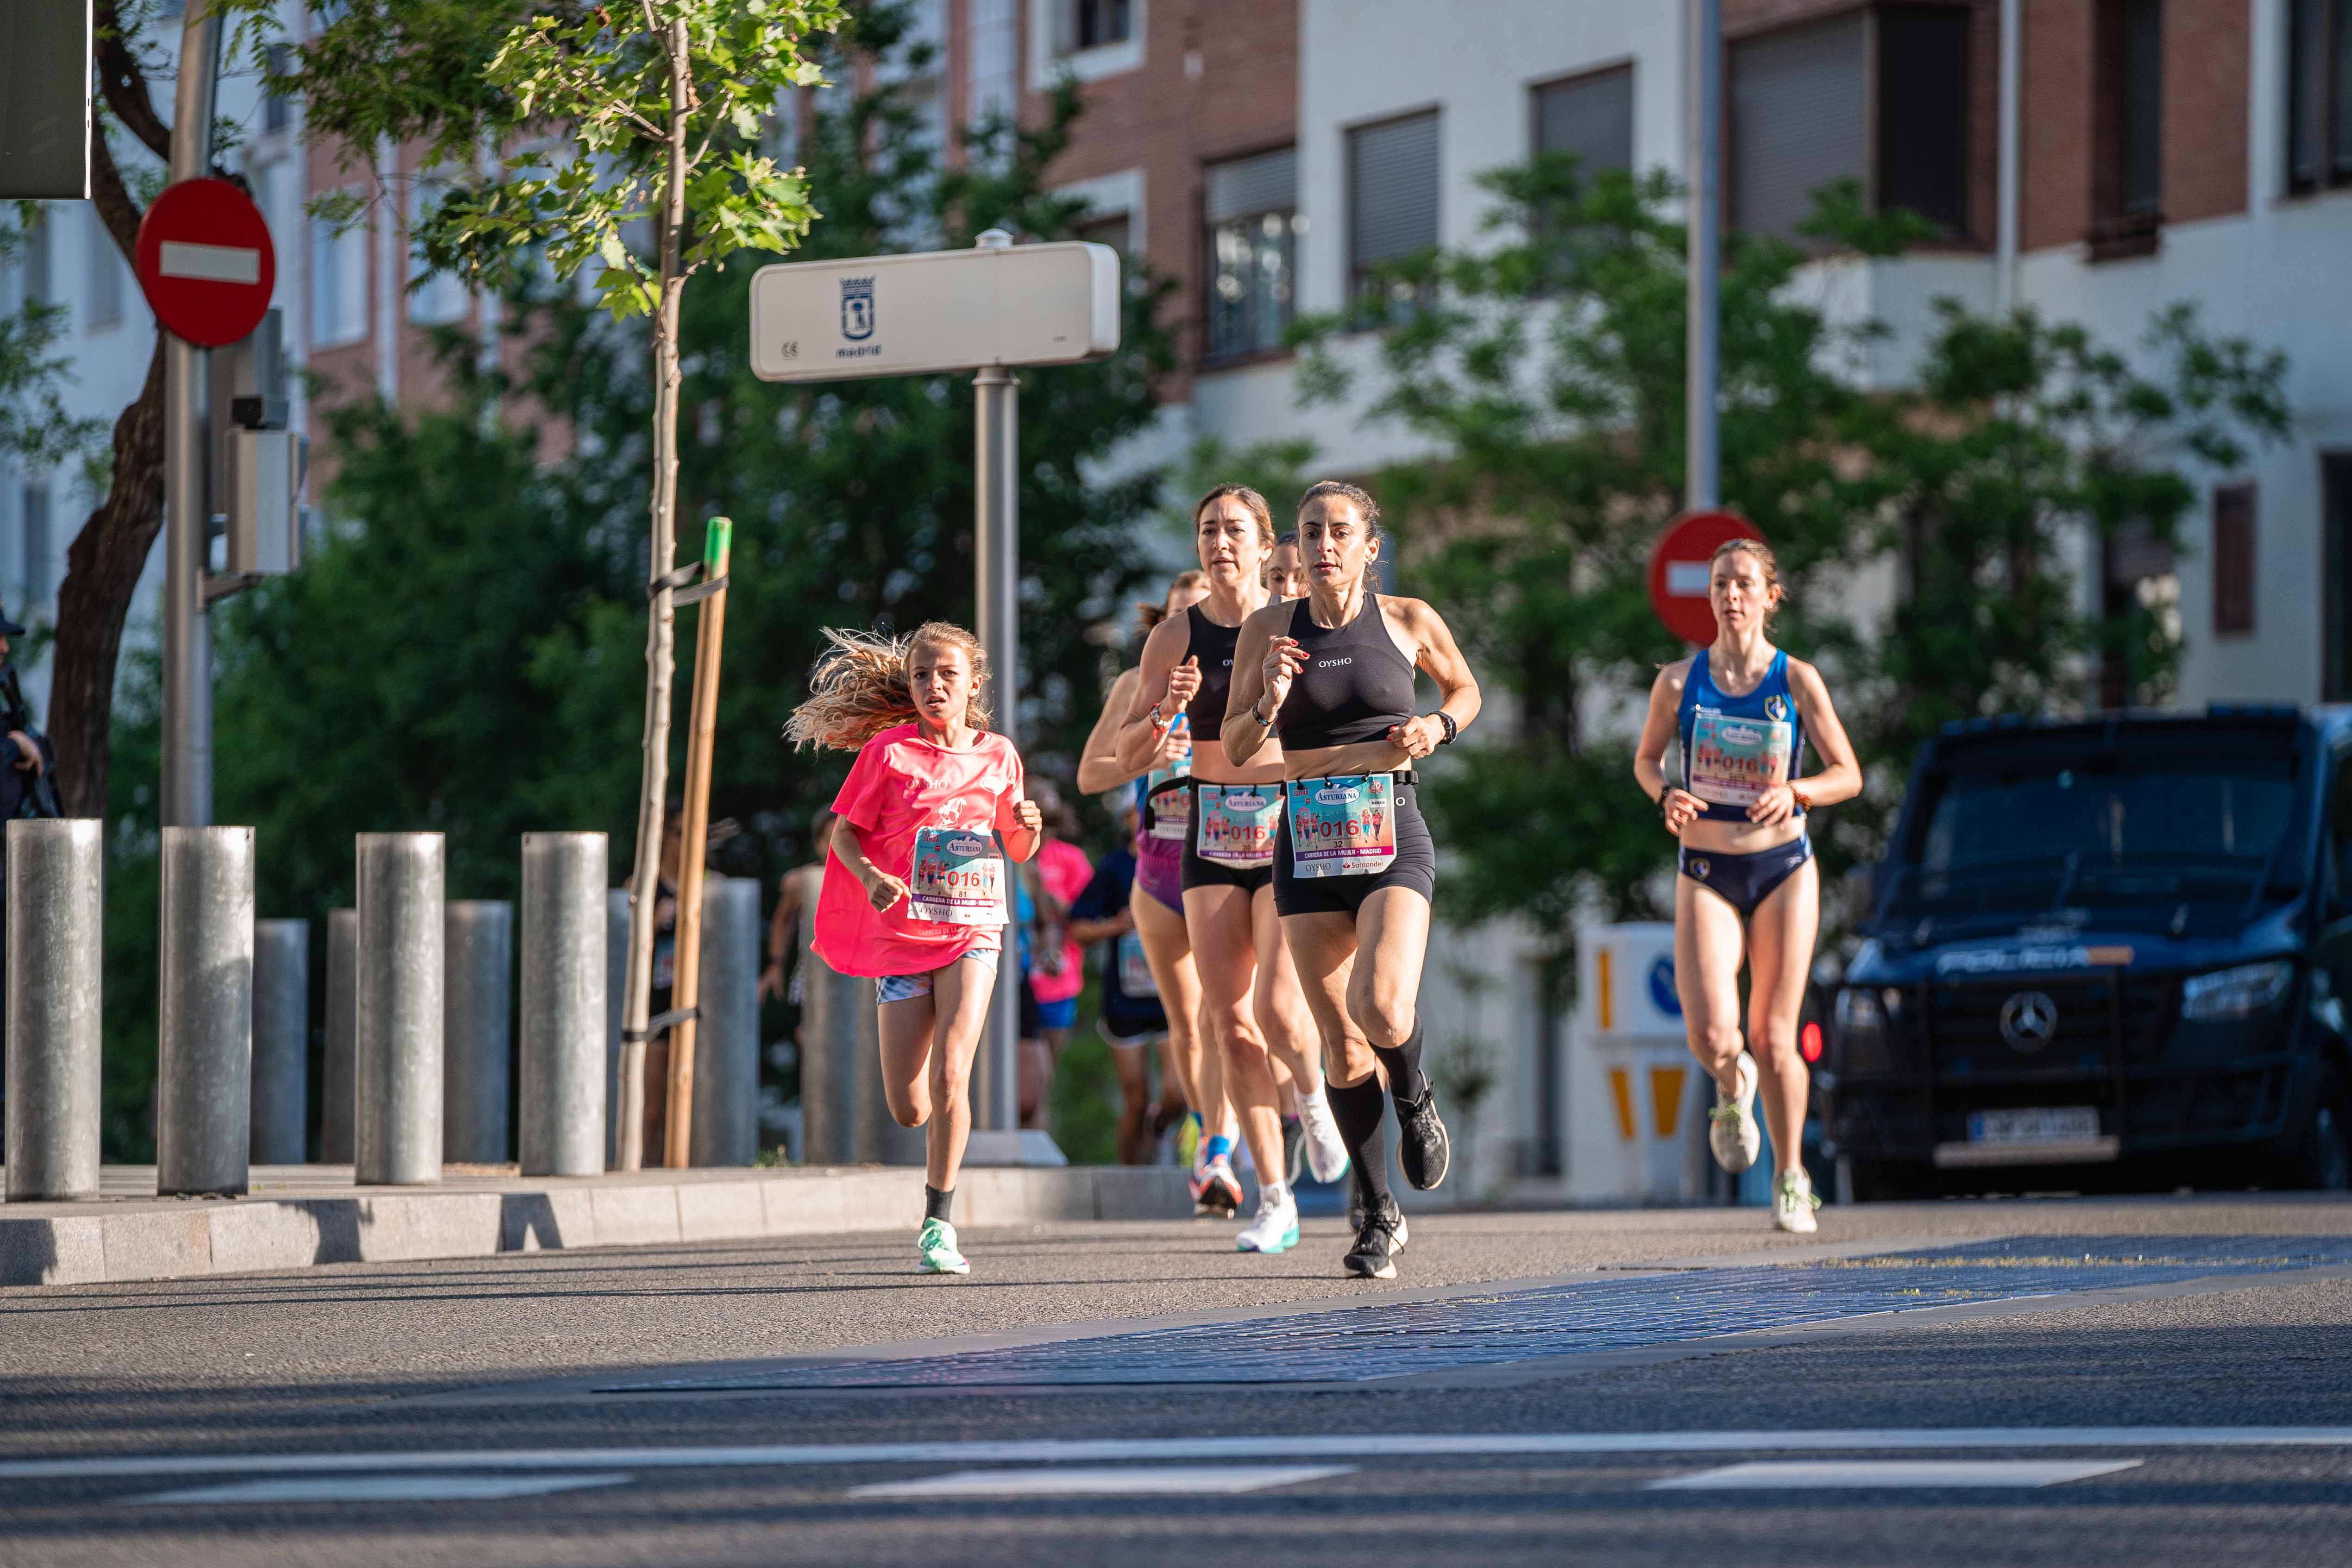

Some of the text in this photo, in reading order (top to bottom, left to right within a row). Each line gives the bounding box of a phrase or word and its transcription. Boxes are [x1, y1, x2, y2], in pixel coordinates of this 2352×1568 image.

[835, 344, 881, 359] madrid
[1319, 657, 1352, 668] OYSHO
[1723, 756, 1757, 772] 016
[906, 780, 948, 789] OYSHO
[1318, 792, 1356, 801] ASTURIANA
[1231, 825, 1265, 840] 016
[1321, 819, 1359, 837] 016
[1305, 863, 1331, 872] OYSHO
[947, 871, 980, 887] 016
[920, 907, 952, 917] OYSHO
